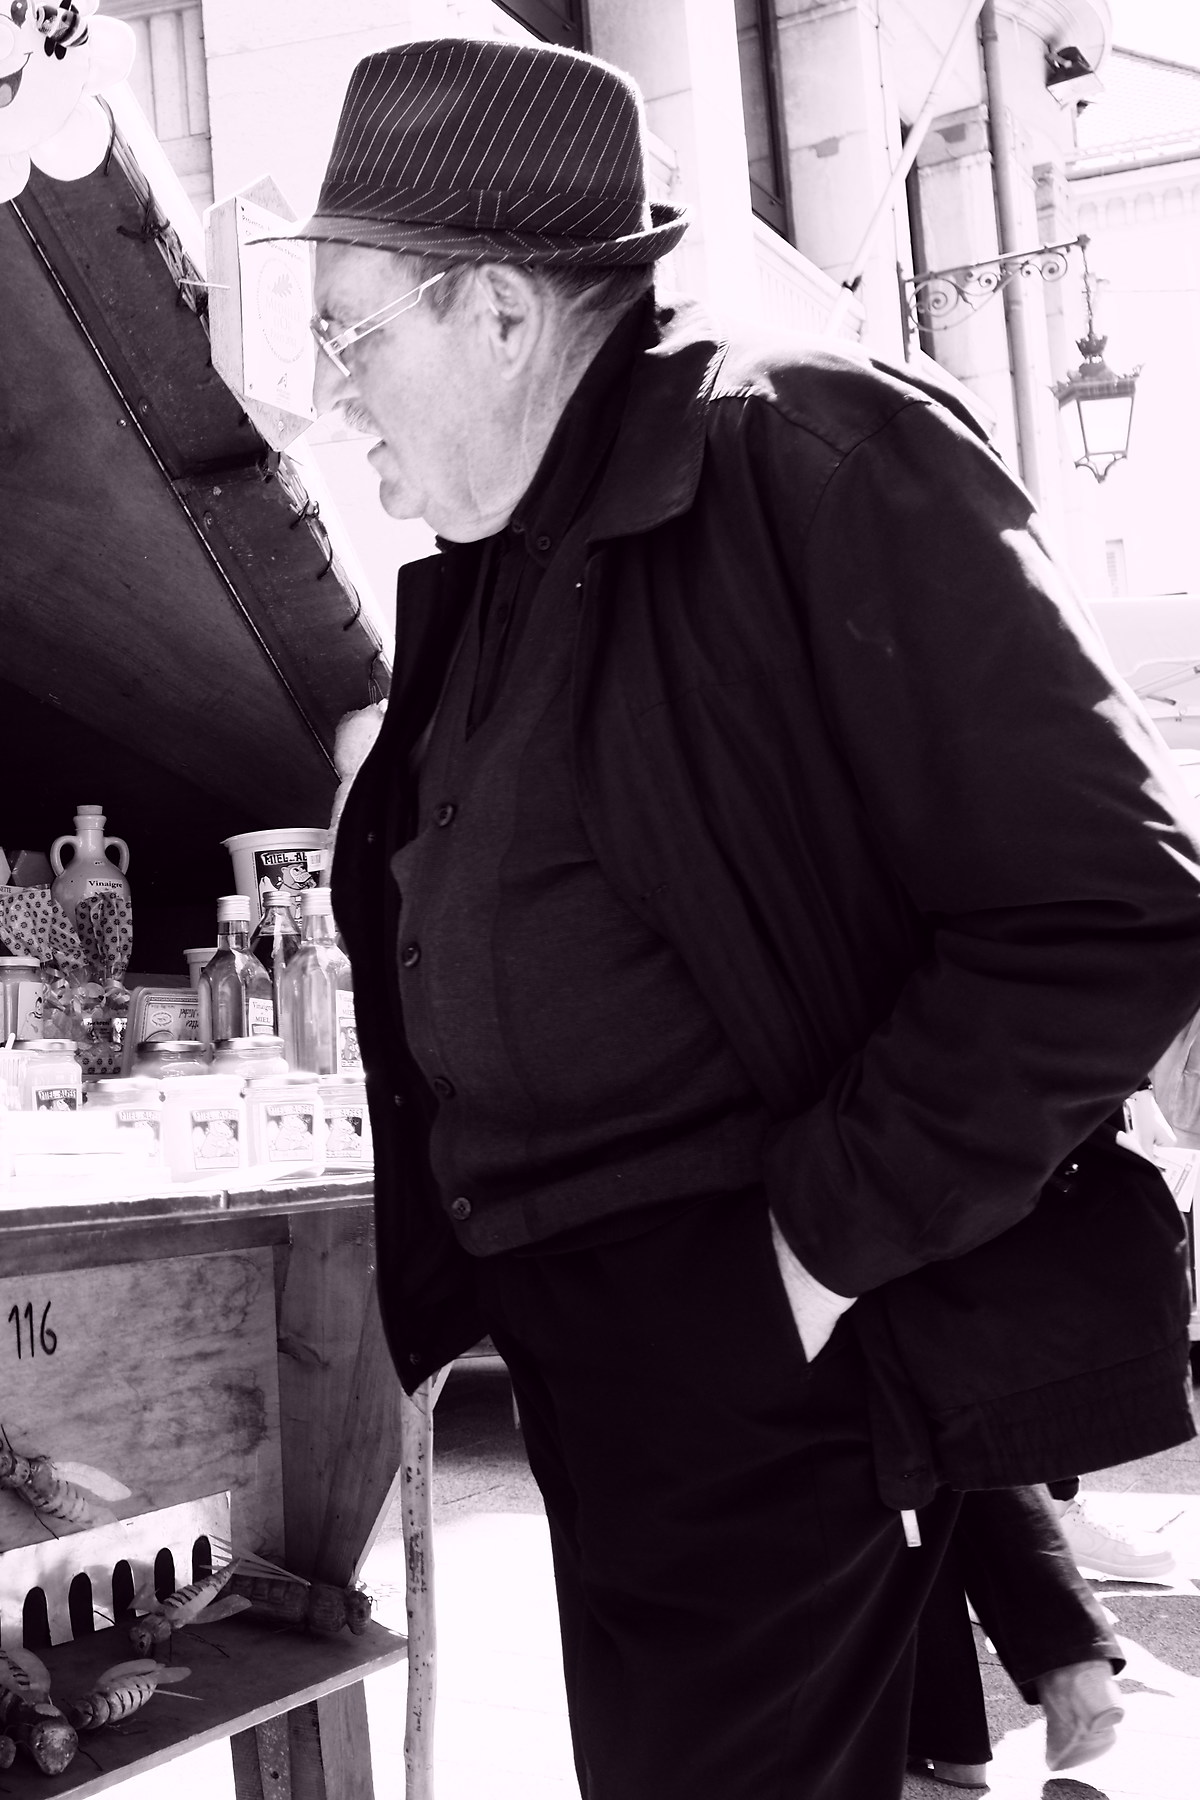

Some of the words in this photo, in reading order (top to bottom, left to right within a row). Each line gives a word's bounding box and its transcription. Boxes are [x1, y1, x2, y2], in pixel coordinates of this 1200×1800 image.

[263, 853, 288, 865] MIEL
[88, 880, 123, 889] Vinaigre
[8, 1301, 57, 1360] 116
